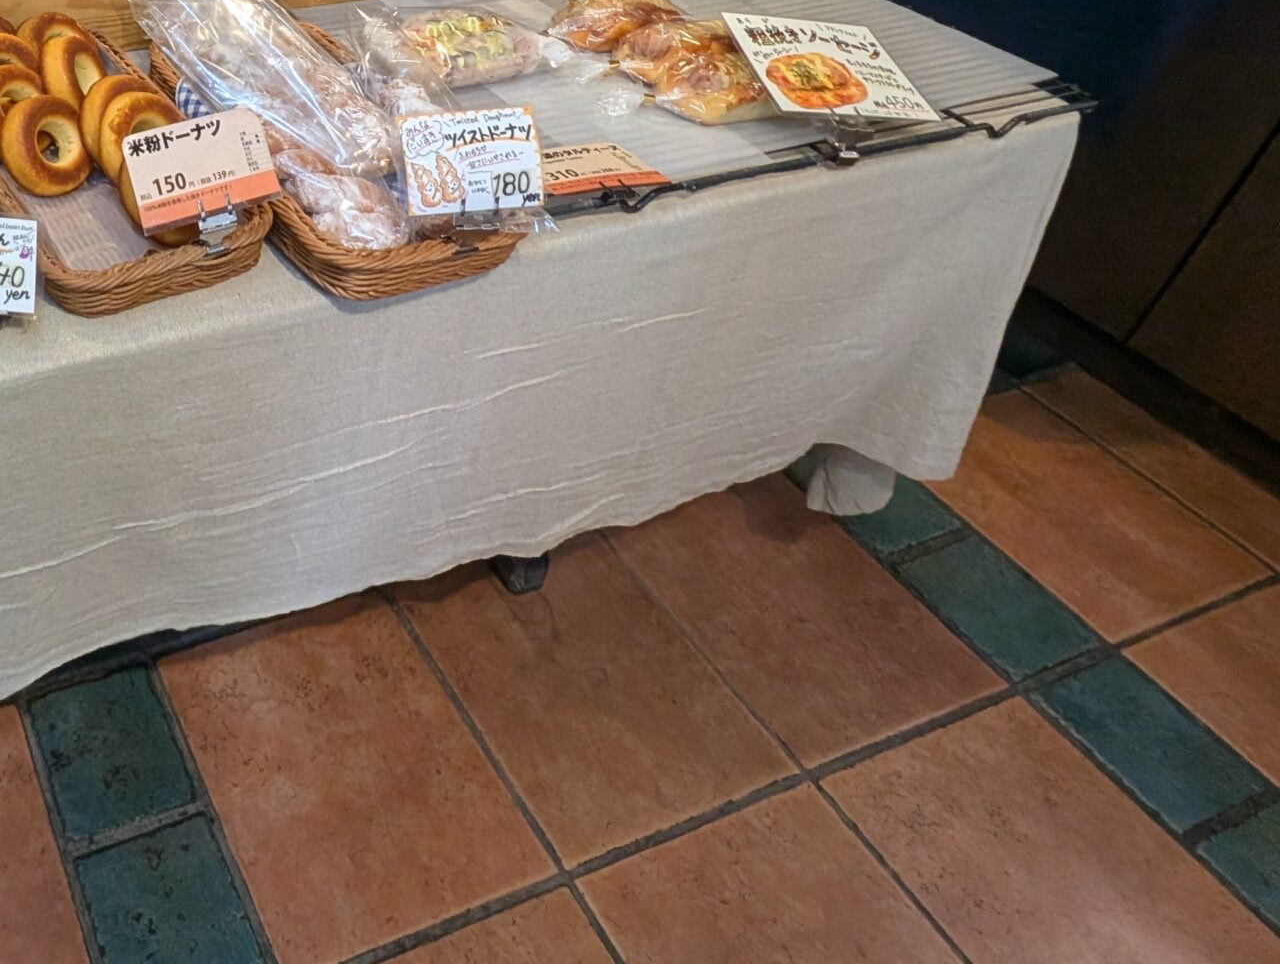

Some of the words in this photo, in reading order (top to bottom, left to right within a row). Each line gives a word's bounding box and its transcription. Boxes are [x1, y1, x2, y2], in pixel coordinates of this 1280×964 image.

[128, 119, 221, 158] 米粉ドーナツ
[444, 123, 531, 148] ツイストドーナツ
[152, 172, 187, 196] 150
[492, 170, 530, 197] 180
[522, 191, 540, 207] yen
[3, 288, 30, 304] yen
